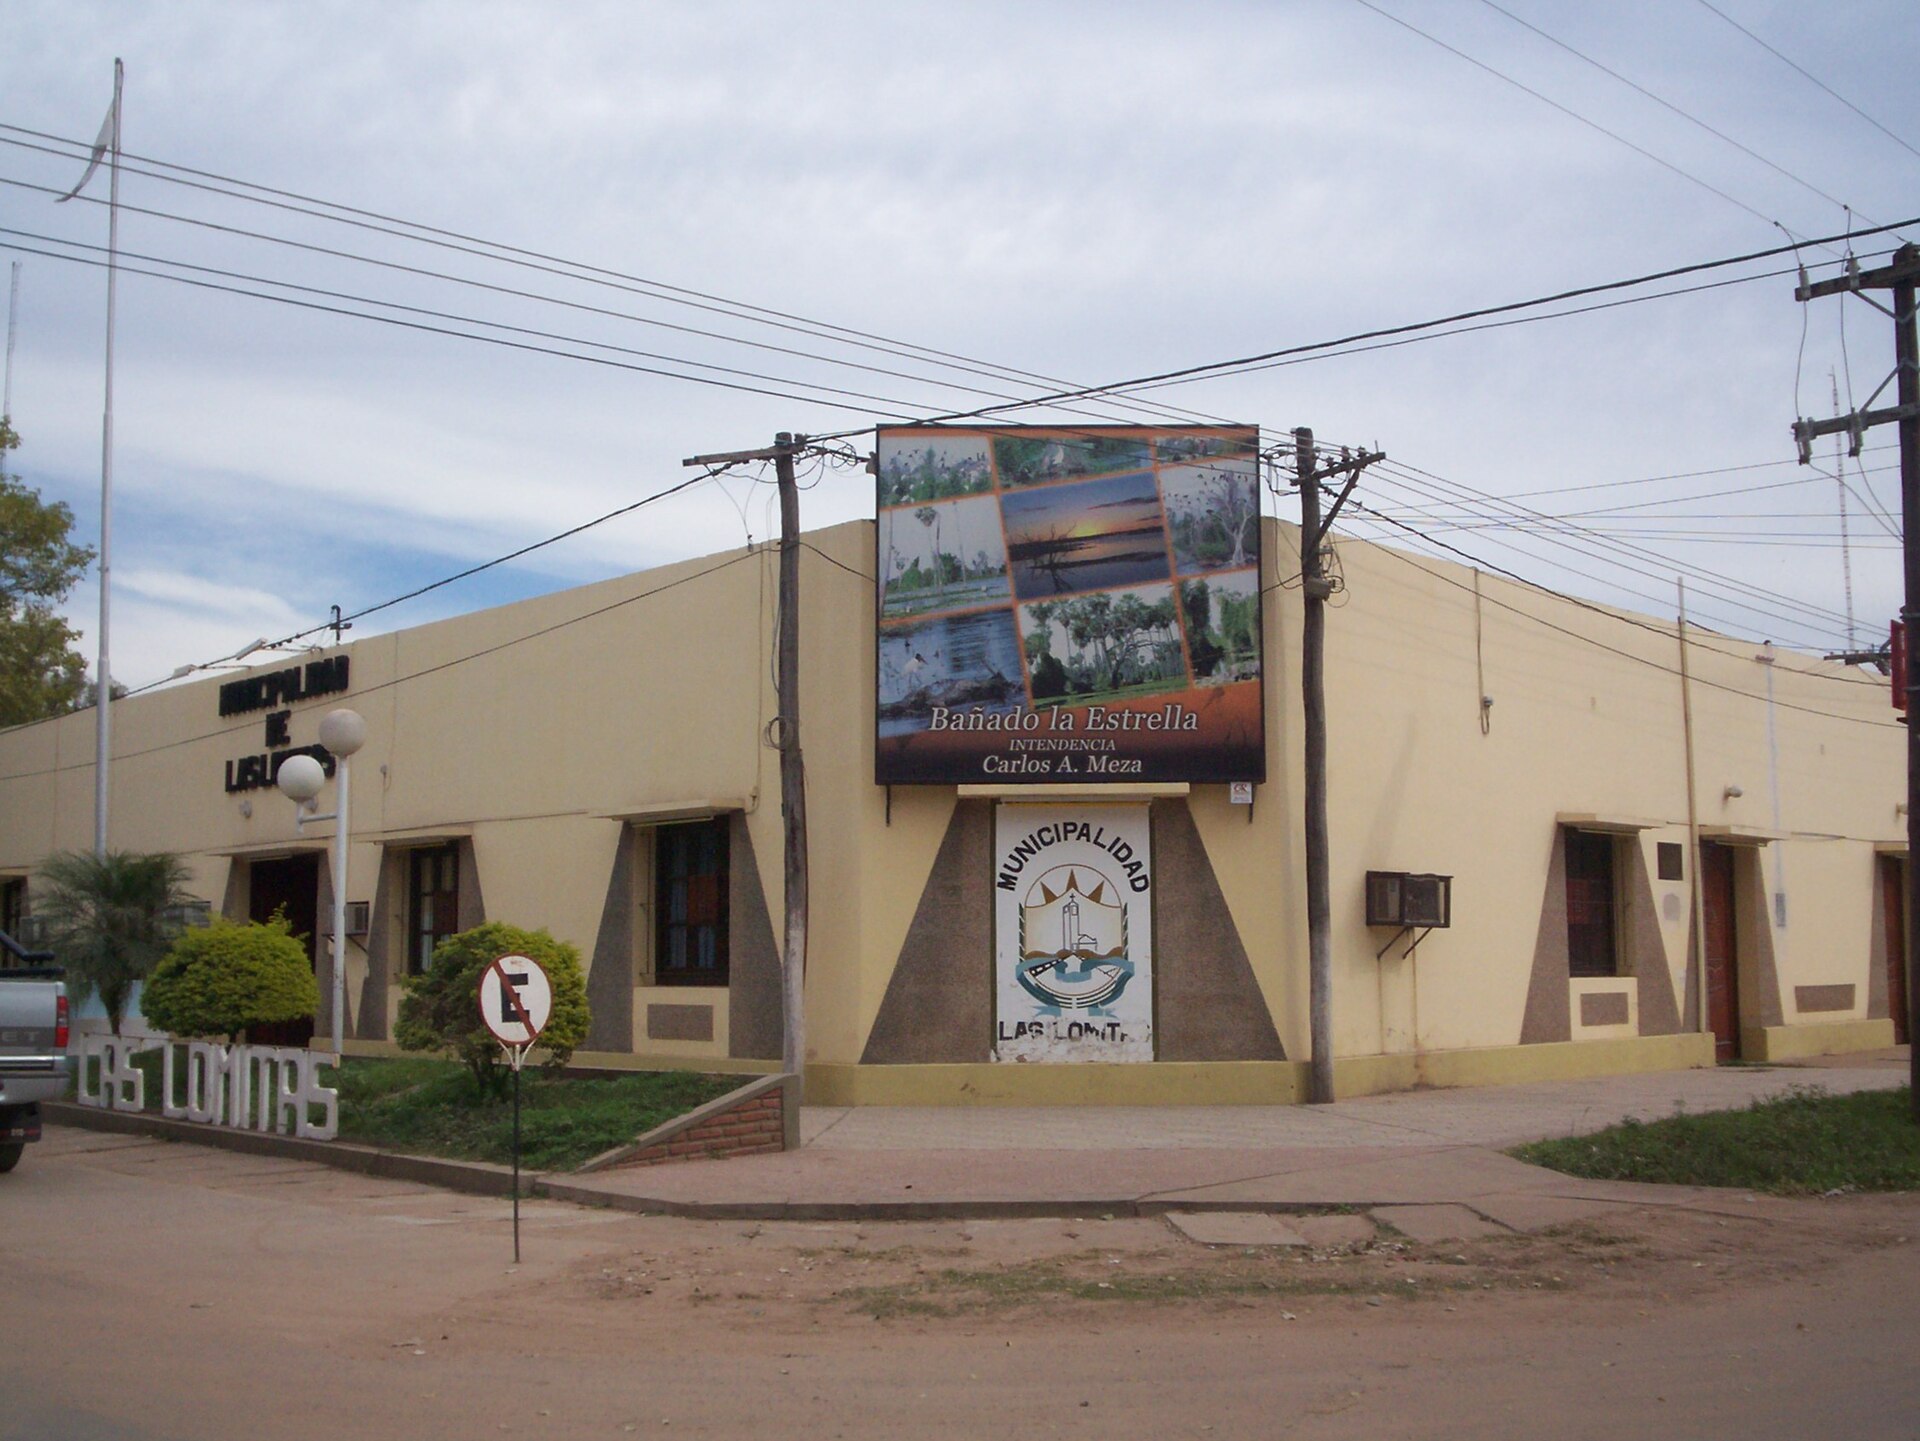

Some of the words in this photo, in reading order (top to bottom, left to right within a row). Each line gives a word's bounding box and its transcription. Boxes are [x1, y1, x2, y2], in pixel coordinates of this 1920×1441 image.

[929, 705, 1040, 731] Bañado
[1049, 705, 1074, 731] la
[1085, 705, 1198, 731] Estrella
[1009, 739, 1116, 751] INTENDENCIA
[983, 754, 1051, 773] Carlos
[1056, 755, 1078, 773] A.
[1087, 755, 1142, 773] Meza
[997, 822, 1150, 893] MUNICIPALIDAD
[500, 973, 530, 1023] E
[999, 1021, 1044, 1041] LAS
[163, 1038, 338, 1141] LOMITAS
